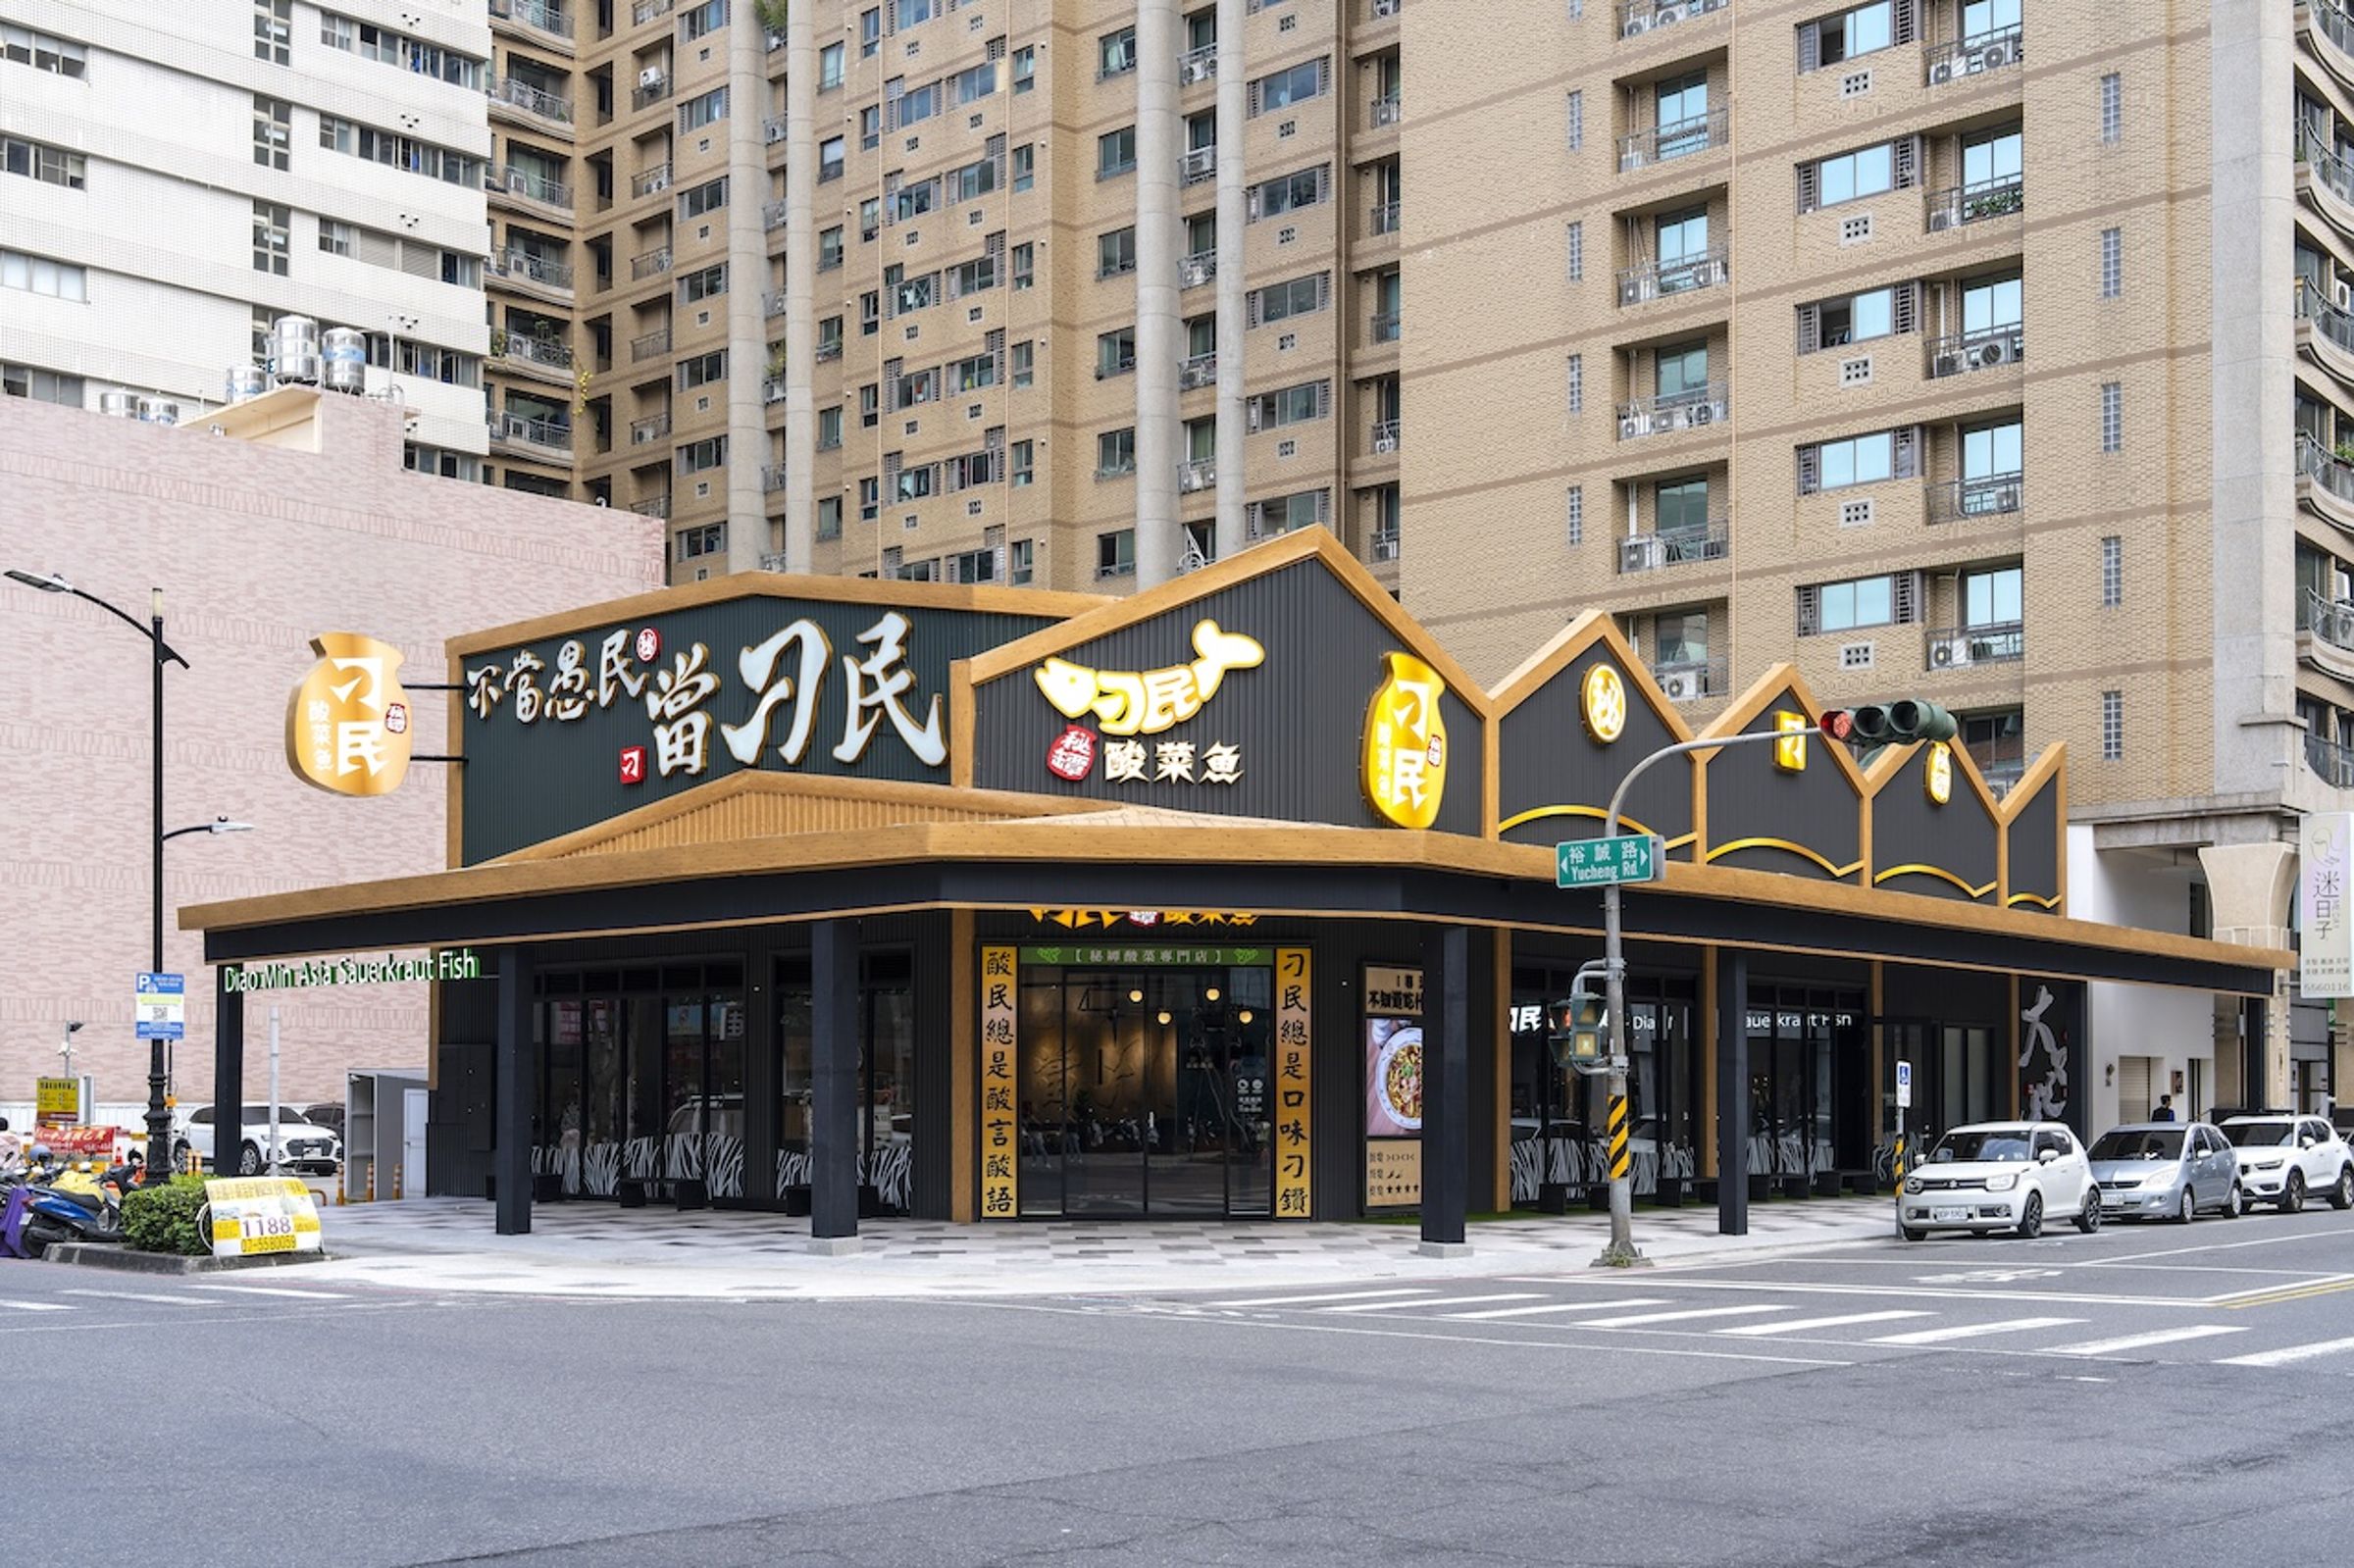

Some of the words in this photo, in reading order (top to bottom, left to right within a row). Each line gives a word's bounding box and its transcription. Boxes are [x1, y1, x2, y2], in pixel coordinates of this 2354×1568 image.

[329, 657, 390, 778] 刁民
[1091, 664, 1203, 735] 刁民
[1103, 738, 1246, 784] 酸菜魚
[1391, 679, 1433, 811] 刁民
[1569, 840, 1638, 864] 裕誠路
[1571, 864, 1618, 882] Yucheng
[2313, 871, 2340, 939] 迷日子
[138, 975, 151, 989] P
[225, 966, 259, 992] Diao
[263, 963, 294, 989] Min
[299, 961, 334, 988] Asia
[338, 953, 435, 986] Sauerkraut
[438, 947, 479, 981] Fish
[986, 951, 1014, 1213] 酸民總是酸言酸語
[1279, 953, 1308, 1213] 刁民總是口味刁鑽
[243, 1216, 291, 1238] 1188
